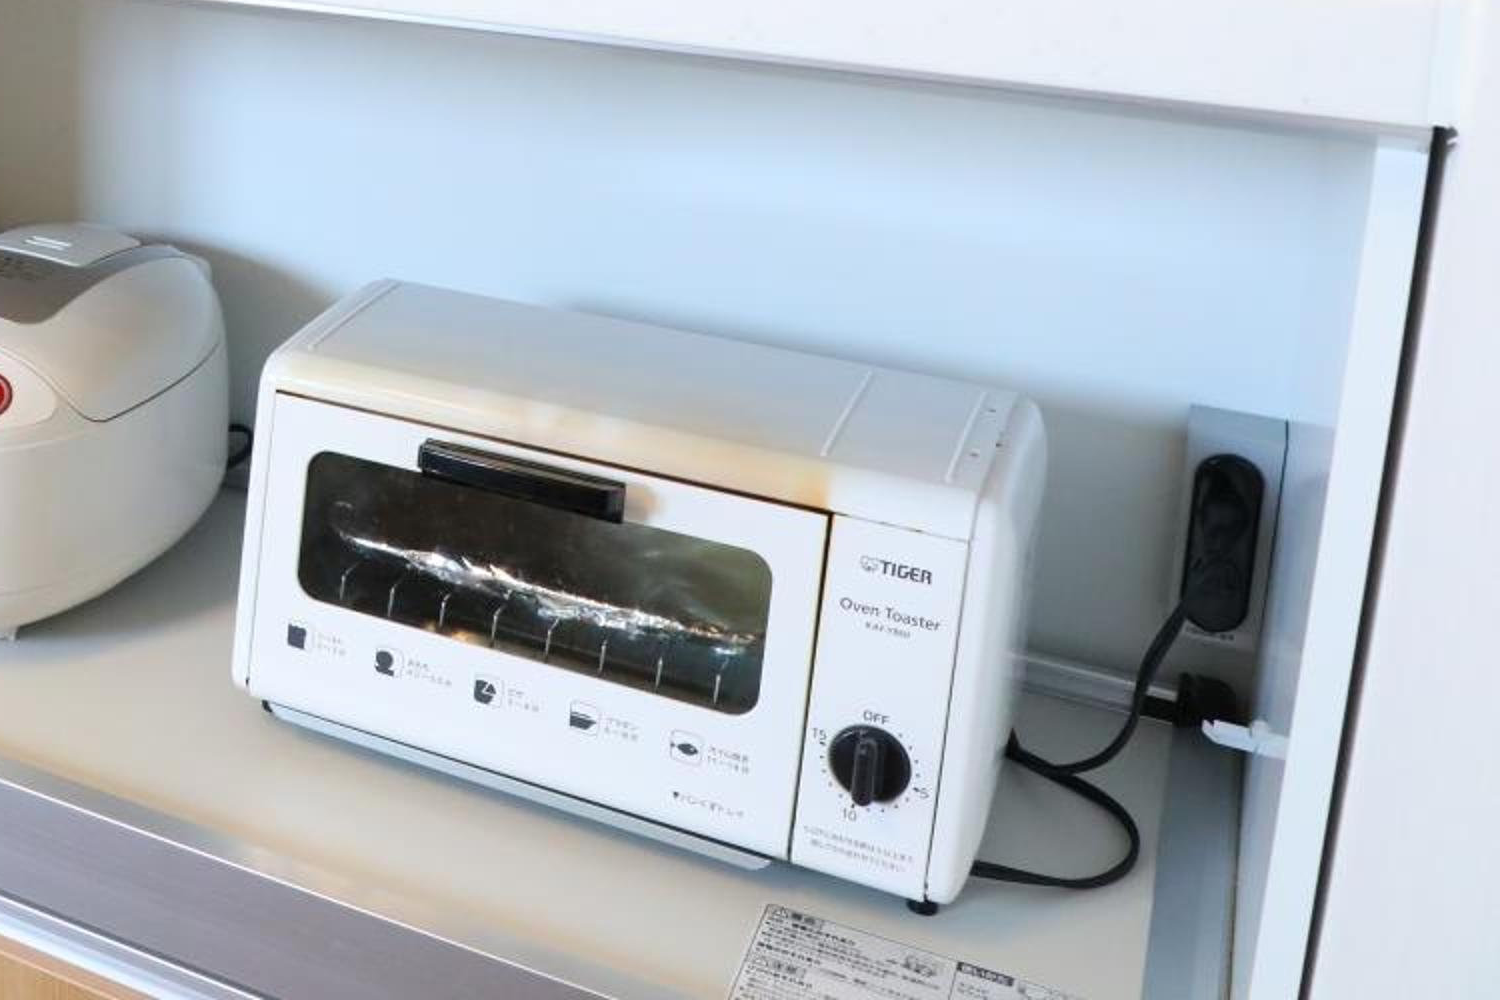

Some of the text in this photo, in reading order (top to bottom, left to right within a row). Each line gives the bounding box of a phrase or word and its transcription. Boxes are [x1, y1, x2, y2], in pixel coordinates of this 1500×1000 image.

[880, 559, 933, 585] TIGER
[839, 596, 880, 617] Oven
[884, 607, 941, 631] Toaster
[862, 709, 891, 726] OFF
[811, 727, 828, 742] 15
[919, 787, 930, 799] 5
[842, 807, 858, 822] 10
